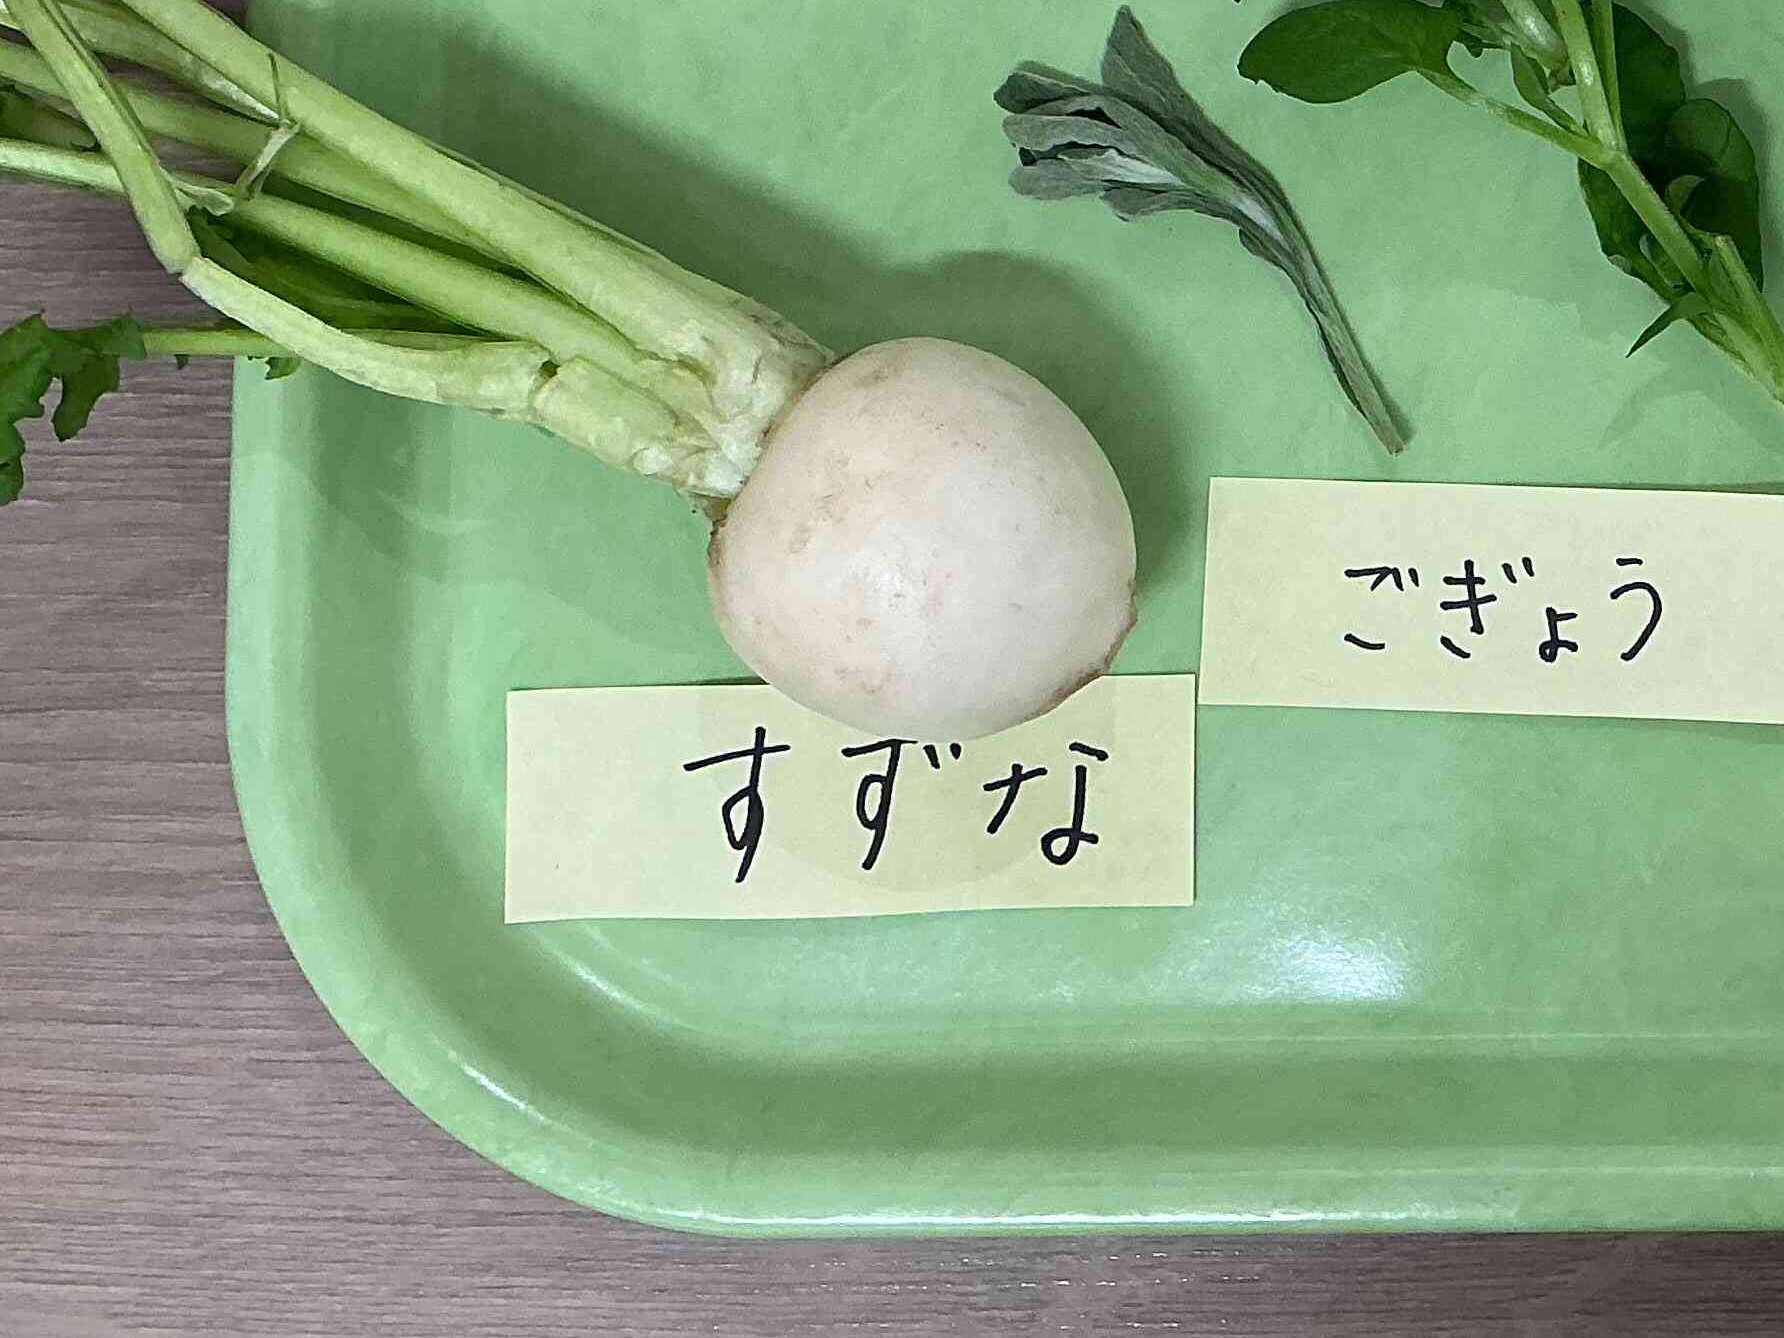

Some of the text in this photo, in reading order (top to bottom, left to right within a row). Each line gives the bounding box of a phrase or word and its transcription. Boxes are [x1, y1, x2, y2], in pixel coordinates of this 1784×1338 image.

[1341, 555, 1665, 664] ごぎょう
[682, 725, 1111, 884] すずな
